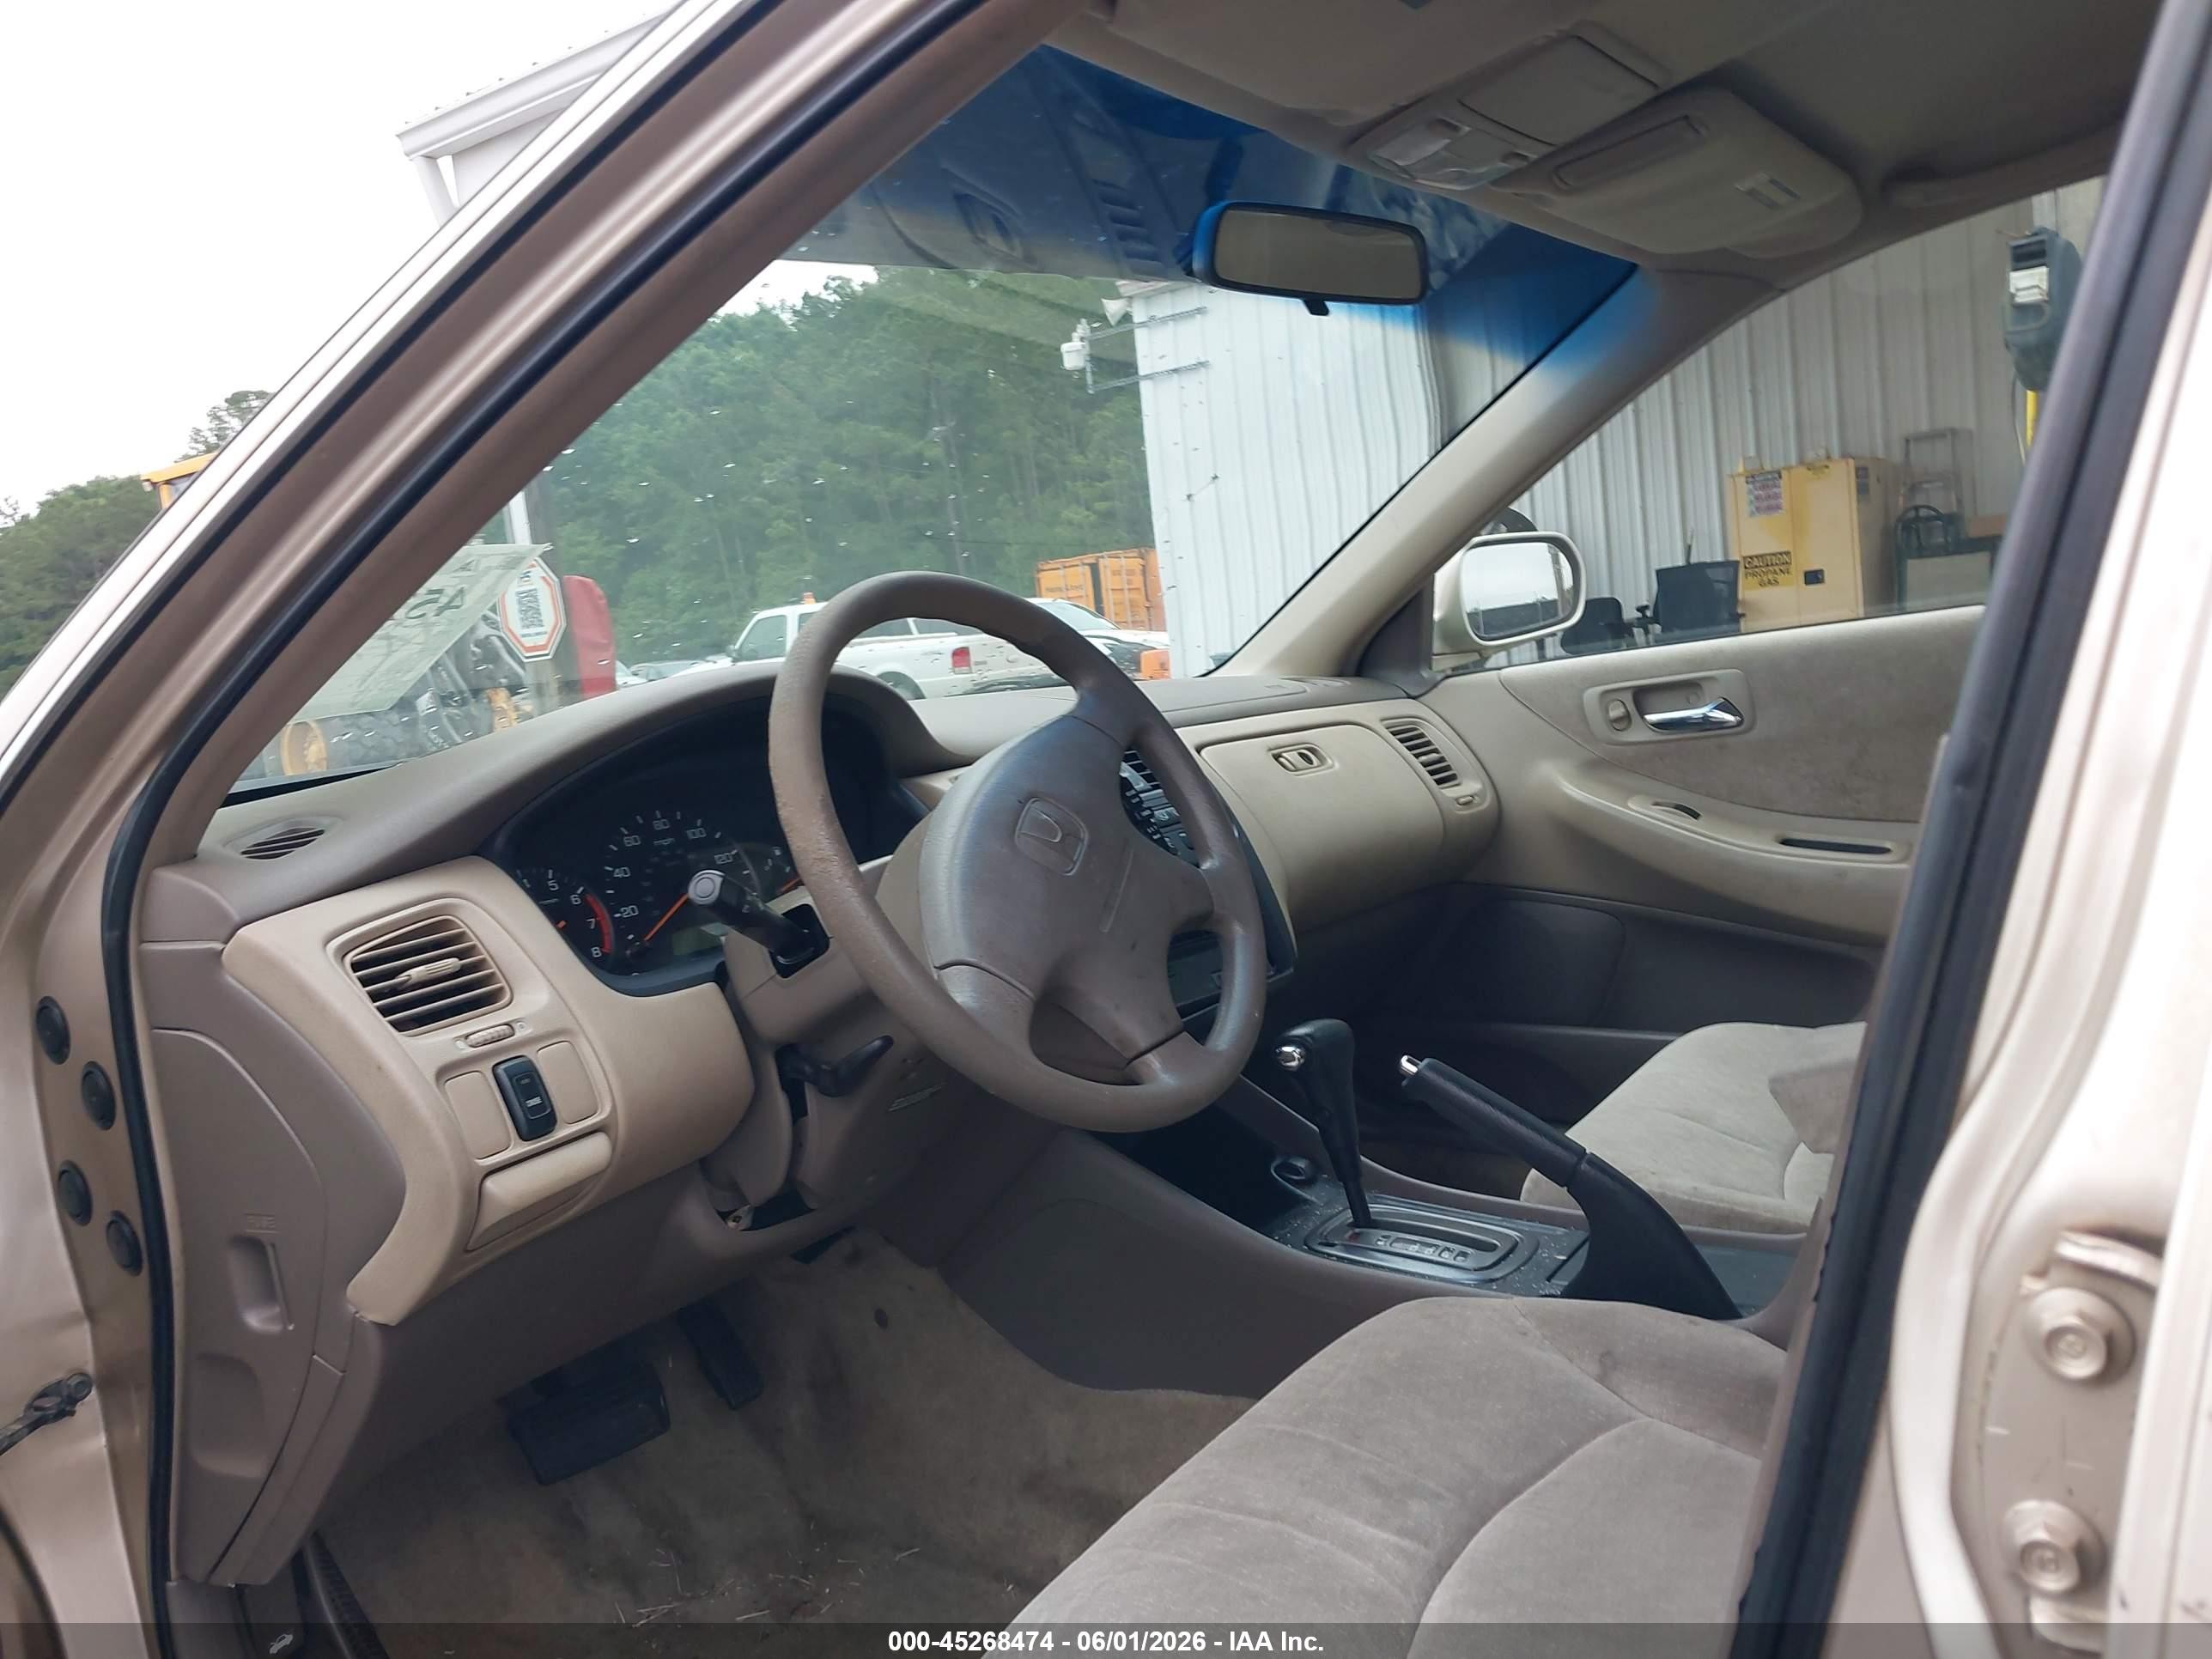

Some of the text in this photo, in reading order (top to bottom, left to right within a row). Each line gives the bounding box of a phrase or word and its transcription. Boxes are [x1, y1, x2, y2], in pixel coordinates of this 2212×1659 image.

[1745, 553, 1791, 568] CAUTION
[653, 819, 670, 830] 80
[686, 828, 707, 839] 100
[624, 836, 641, 847] 60
[714, 853, 733, 865] 120
[614, 866, 630, 878] 40
[547, 880, 559, 890] 5
[570, 894, 581, 904] 6
[621, 905, 639, 918] 20
[586, 918, 596, 929] 7
[592, 946, 602, 957] 8
